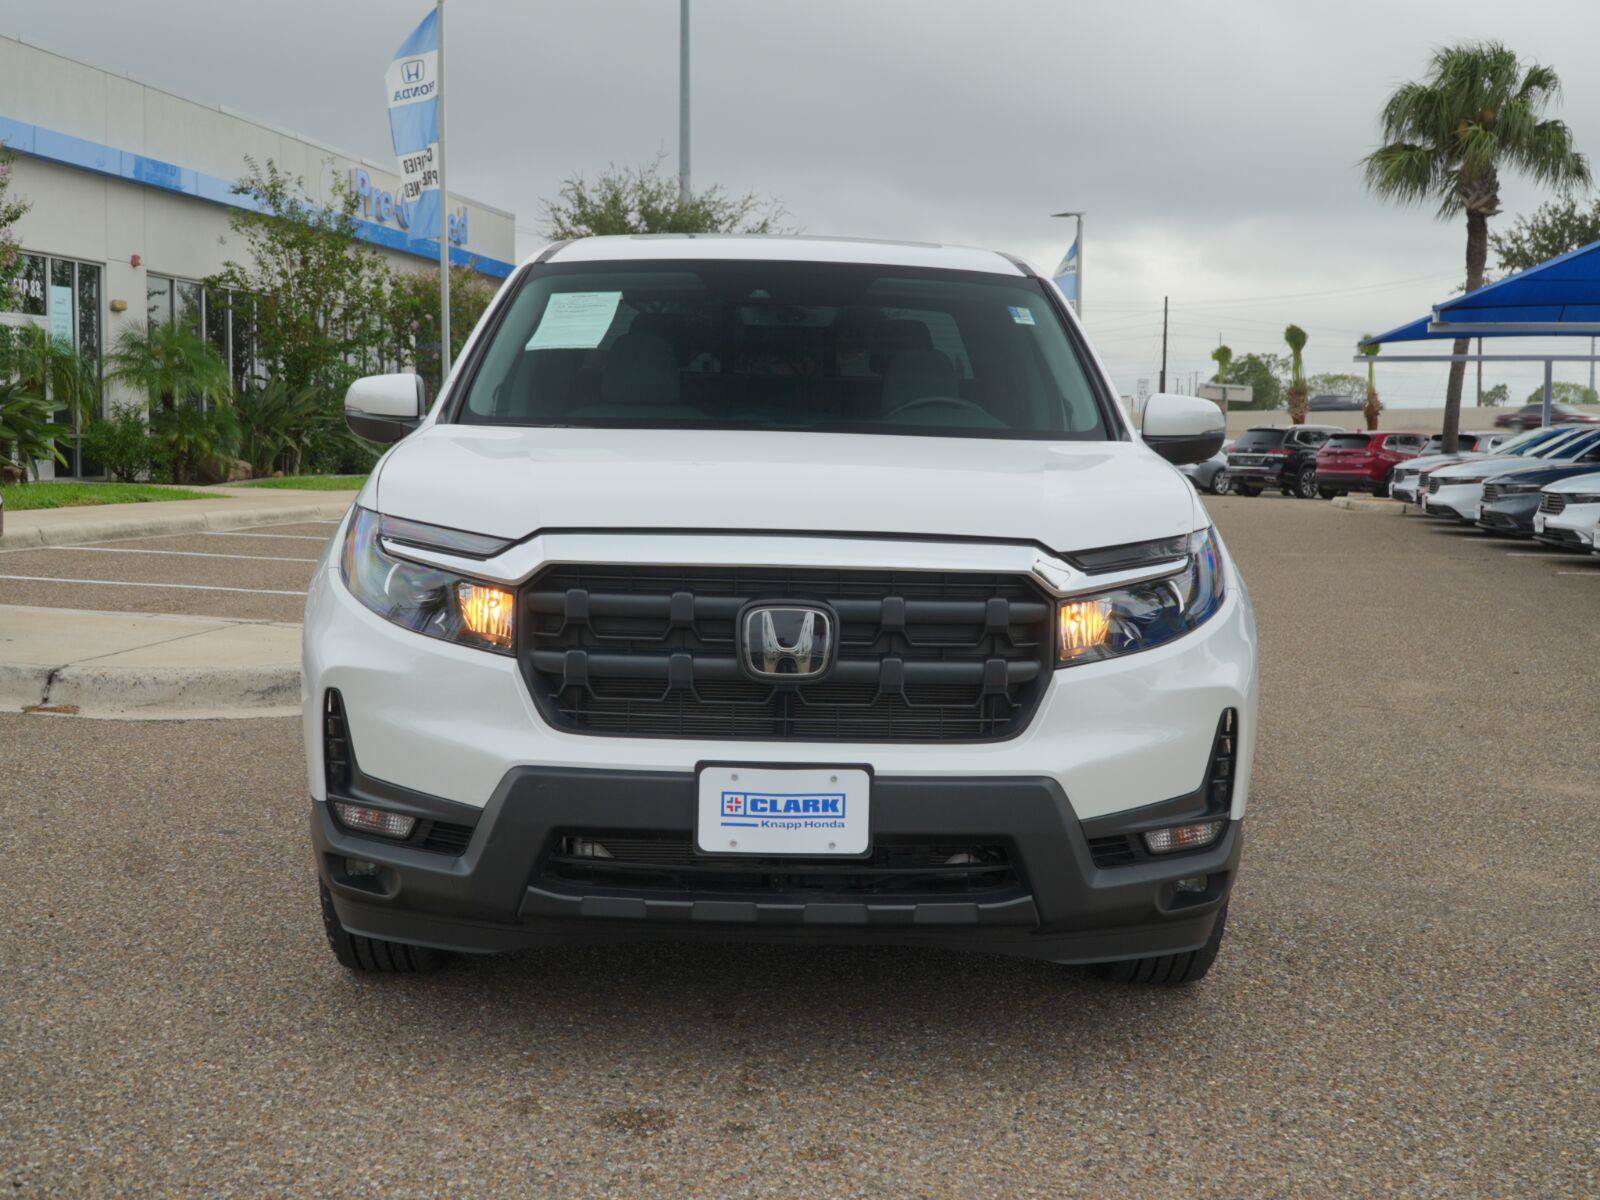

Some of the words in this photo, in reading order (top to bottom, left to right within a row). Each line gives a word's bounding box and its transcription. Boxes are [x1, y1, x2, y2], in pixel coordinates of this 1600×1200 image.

[750, 798, 839, 813] CLARK
[761, 820, 802, 830] Knapp
[804, 820, 845, 829] Honda
